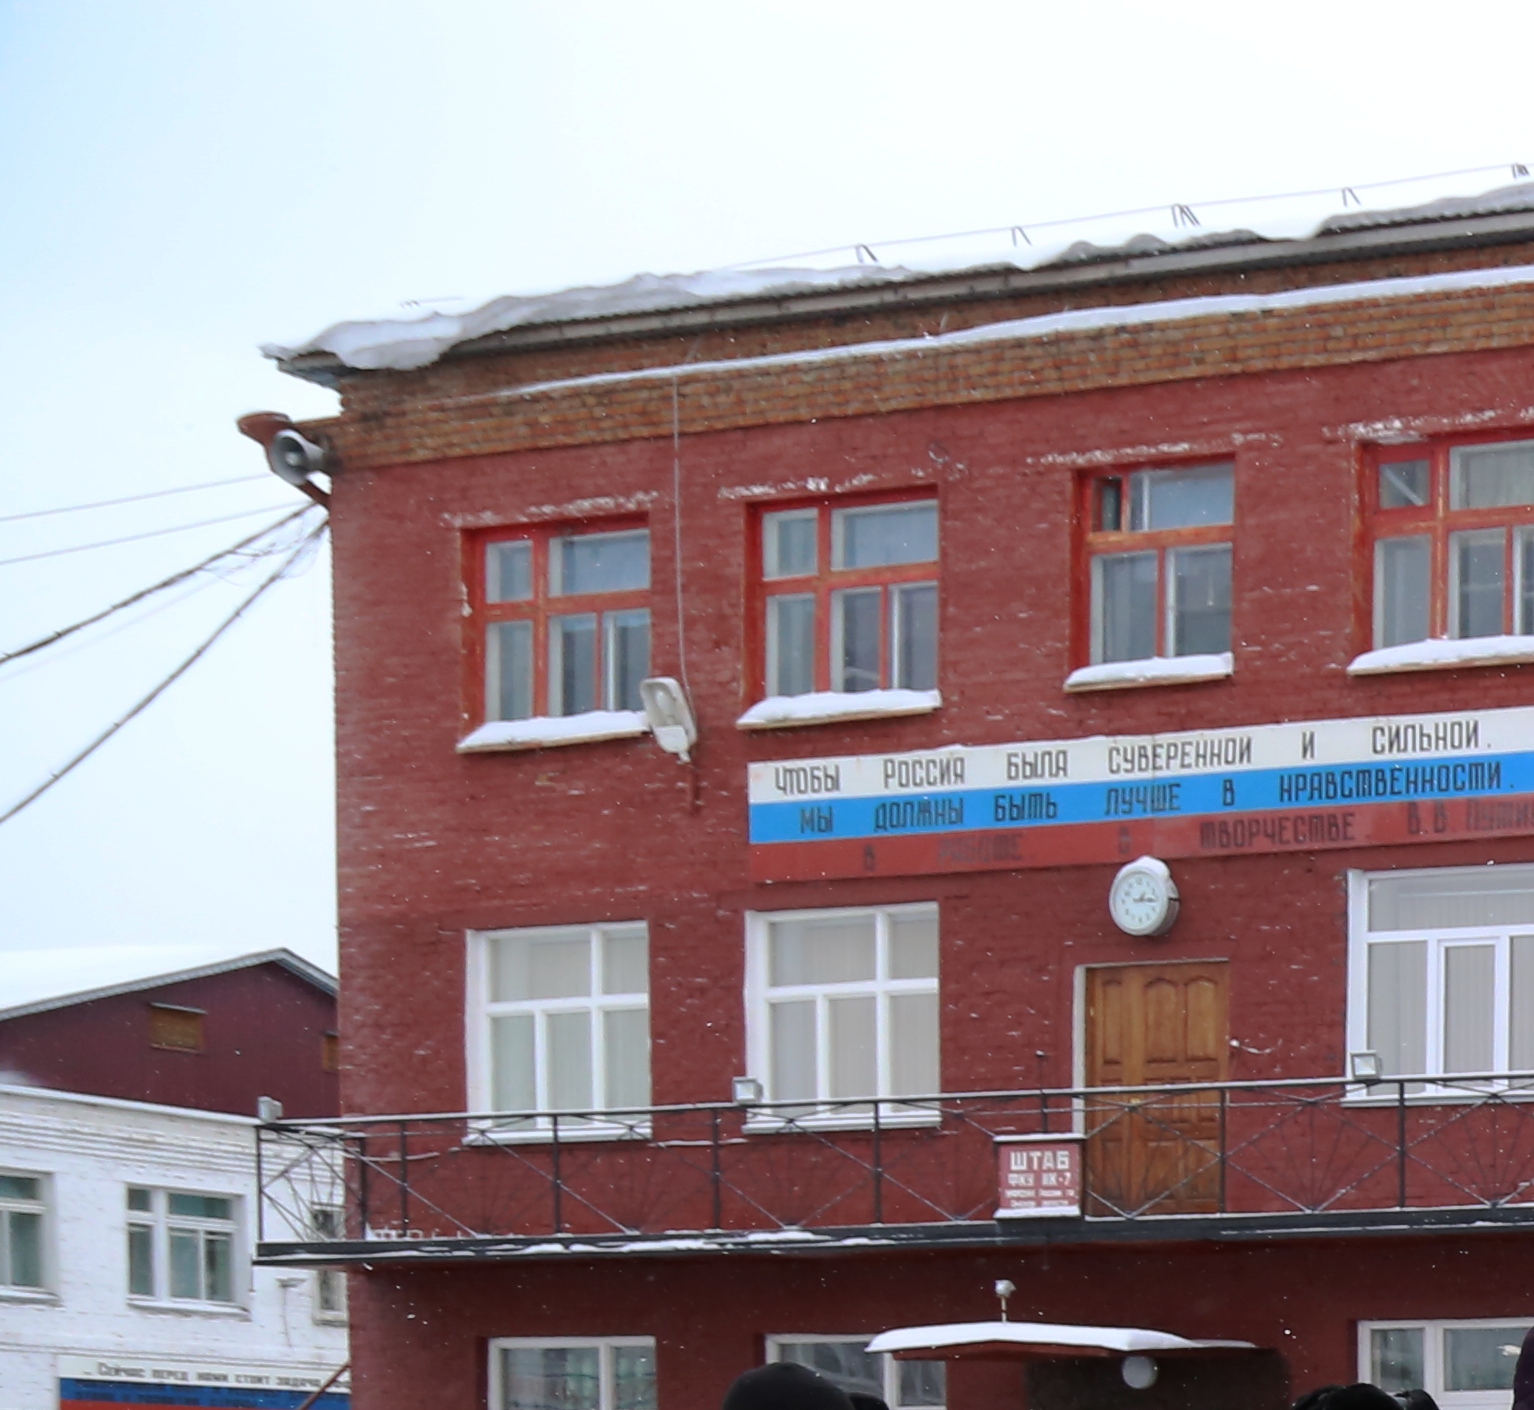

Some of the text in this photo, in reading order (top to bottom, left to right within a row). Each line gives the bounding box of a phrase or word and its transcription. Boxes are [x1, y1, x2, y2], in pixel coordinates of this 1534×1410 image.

[774, 764, 841, 795] ЧТОБЫ
[882, 756, 966, 790] РОССИЯ
[1006, 749, 1069, 781] БЫЛА
[1301, 730, 1316, 760] И
[800, 805, 834, 835] МЫ
[873, 797, 964, 833] ДОЛЖНЫ
[994, 792, 1058, 822] БЫТЬ
[1104, 783, 1182, 816] ЛУЧШЕ
[1222, 778, 1236, 807] В
[1009, 1150, 1070, 1171] ШТАБ
